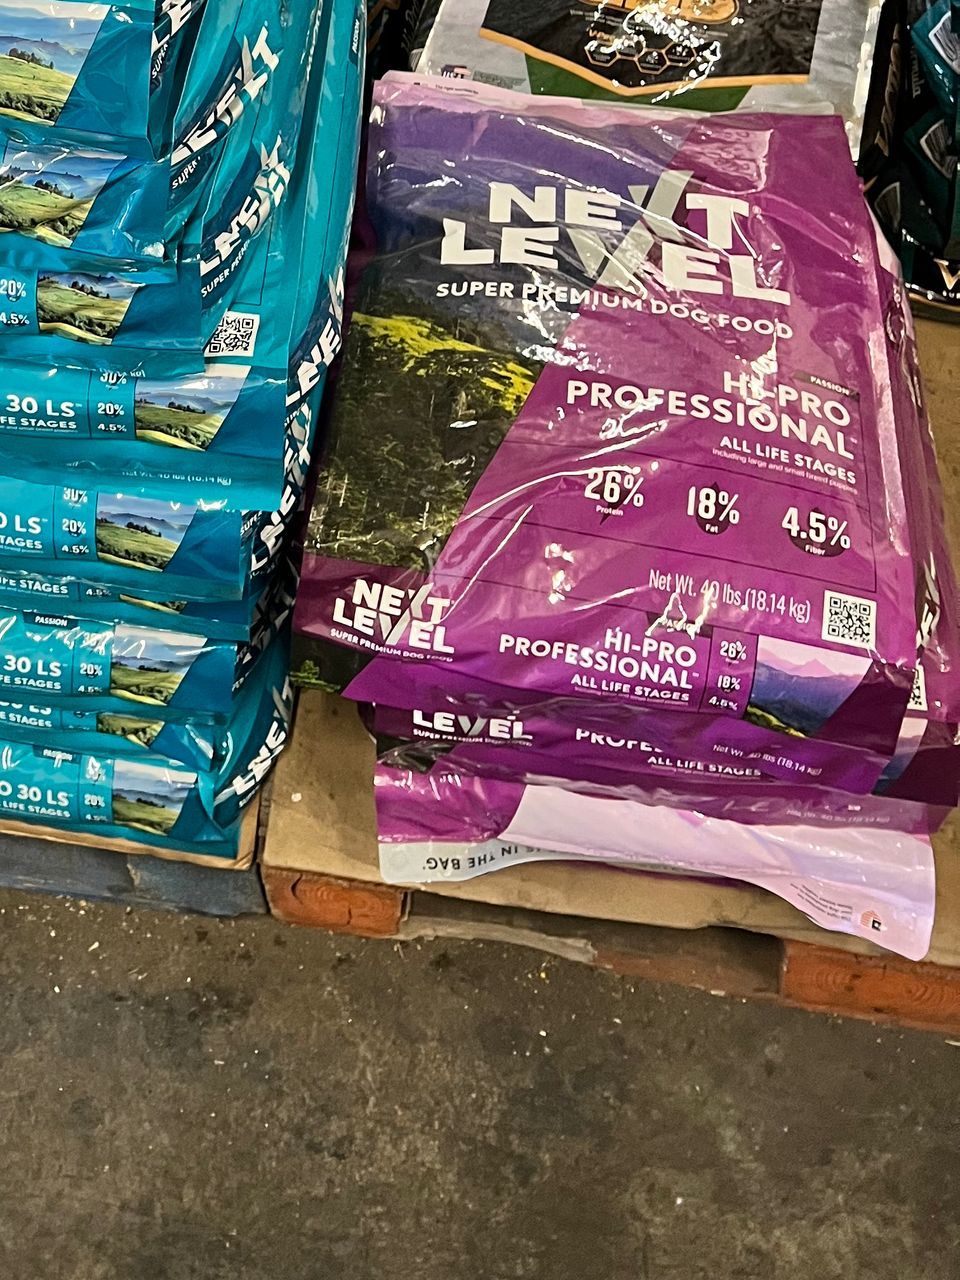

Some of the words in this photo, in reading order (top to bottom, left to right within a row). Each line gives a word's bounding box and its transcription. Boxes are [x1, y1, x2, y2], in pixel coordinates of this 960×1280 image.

[488, 170, 750, 251] NEXT
[440, 217, 792, 307] LEVEL
[436, 281, 515, 299] SUPER
[521, 284, 645, 312] PREMIUM
[651, 297, 710, 326] DOG
[719, 313, 794, 340] FOOD
[566, 379, 857, 461] PROFESSIONAL
[719, 435, 751, 454] ALL
[755, 442, 790, 464] LIFE
[793, 451, 858, 485] STAGES
[584, 470, 644, 509] 26%
[595, 503, 624, 517] Protein
[686, 484, 741, 525] 18%
[705, 523, 719, 534] Fat
[781, 506, 852, 551] 4.5%
[805, 544, 826, 556] Fiber
[351, 578, 452, 626] NEXT
[648, 568, 672, 590] Net
[675, 574, 697, 598] Wt.
[722, 585, 741, 605] lbs
[789, 596, 811, 624] kg)
[333, 597, 455, 655] LEVEL
[358, 637, 401, 656] PREMIUM
[498, 633, 693, 690] PROFESSIONAL
[604, 628, 698, 667] HI-PRO
[571, 673, 598, 690] ALL
[601, 679, 631, 695] LIFE
[634, 684, 690, 703] STAGES
[412, 709, 534, 740] LEVEL
[16, 783, 43, 802] 30
[468, 852, 496, 870] THE
